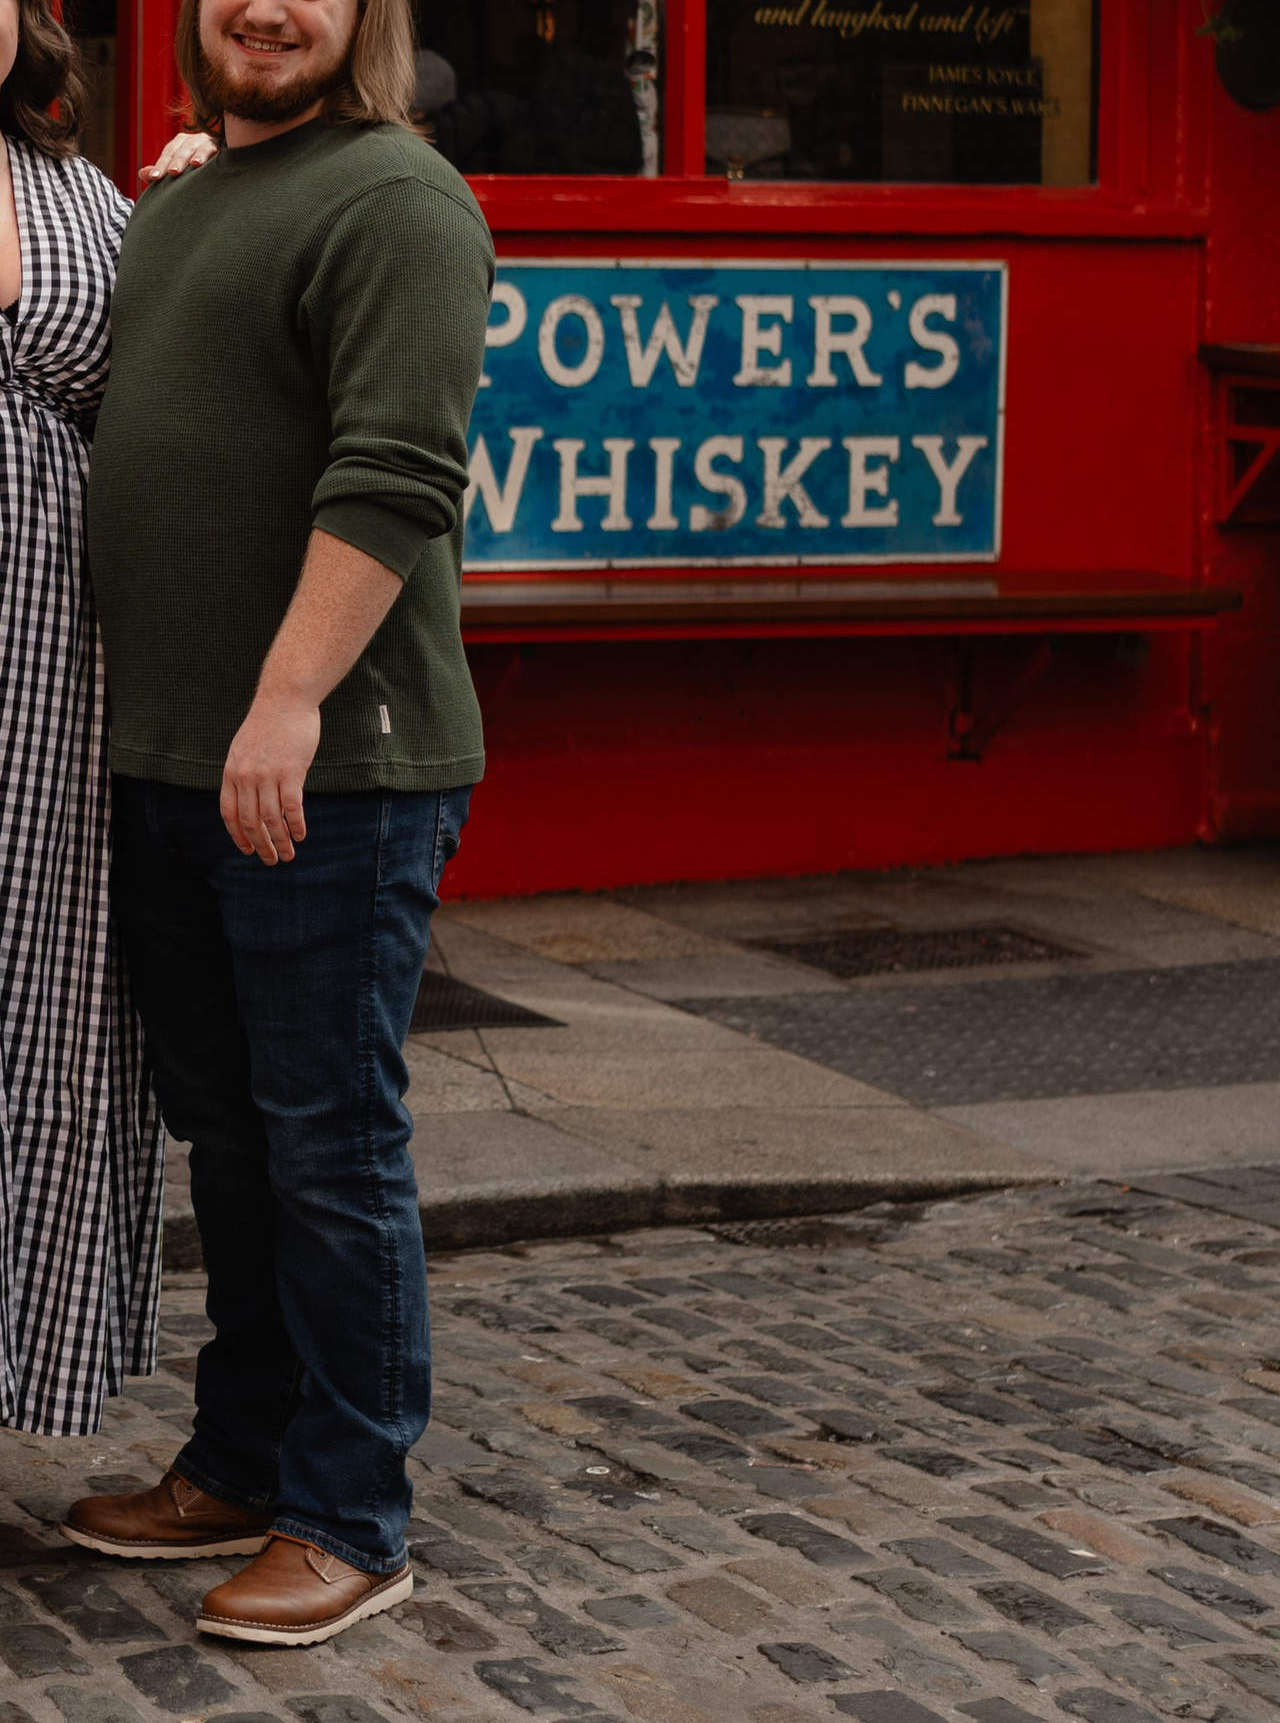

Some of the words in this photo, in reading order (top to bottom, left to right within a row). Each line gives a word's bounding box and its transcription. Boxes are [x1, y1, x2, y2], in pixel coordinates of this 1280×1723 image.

[919, 1, 976, 34] and
[927, 63, 983, 88] JAMES
[986, 66, 1039, 89] JOYCE
[901, 91, 1008, 116] FINNEGAN'S
[463, 426, 988, 534] WHISKEY
